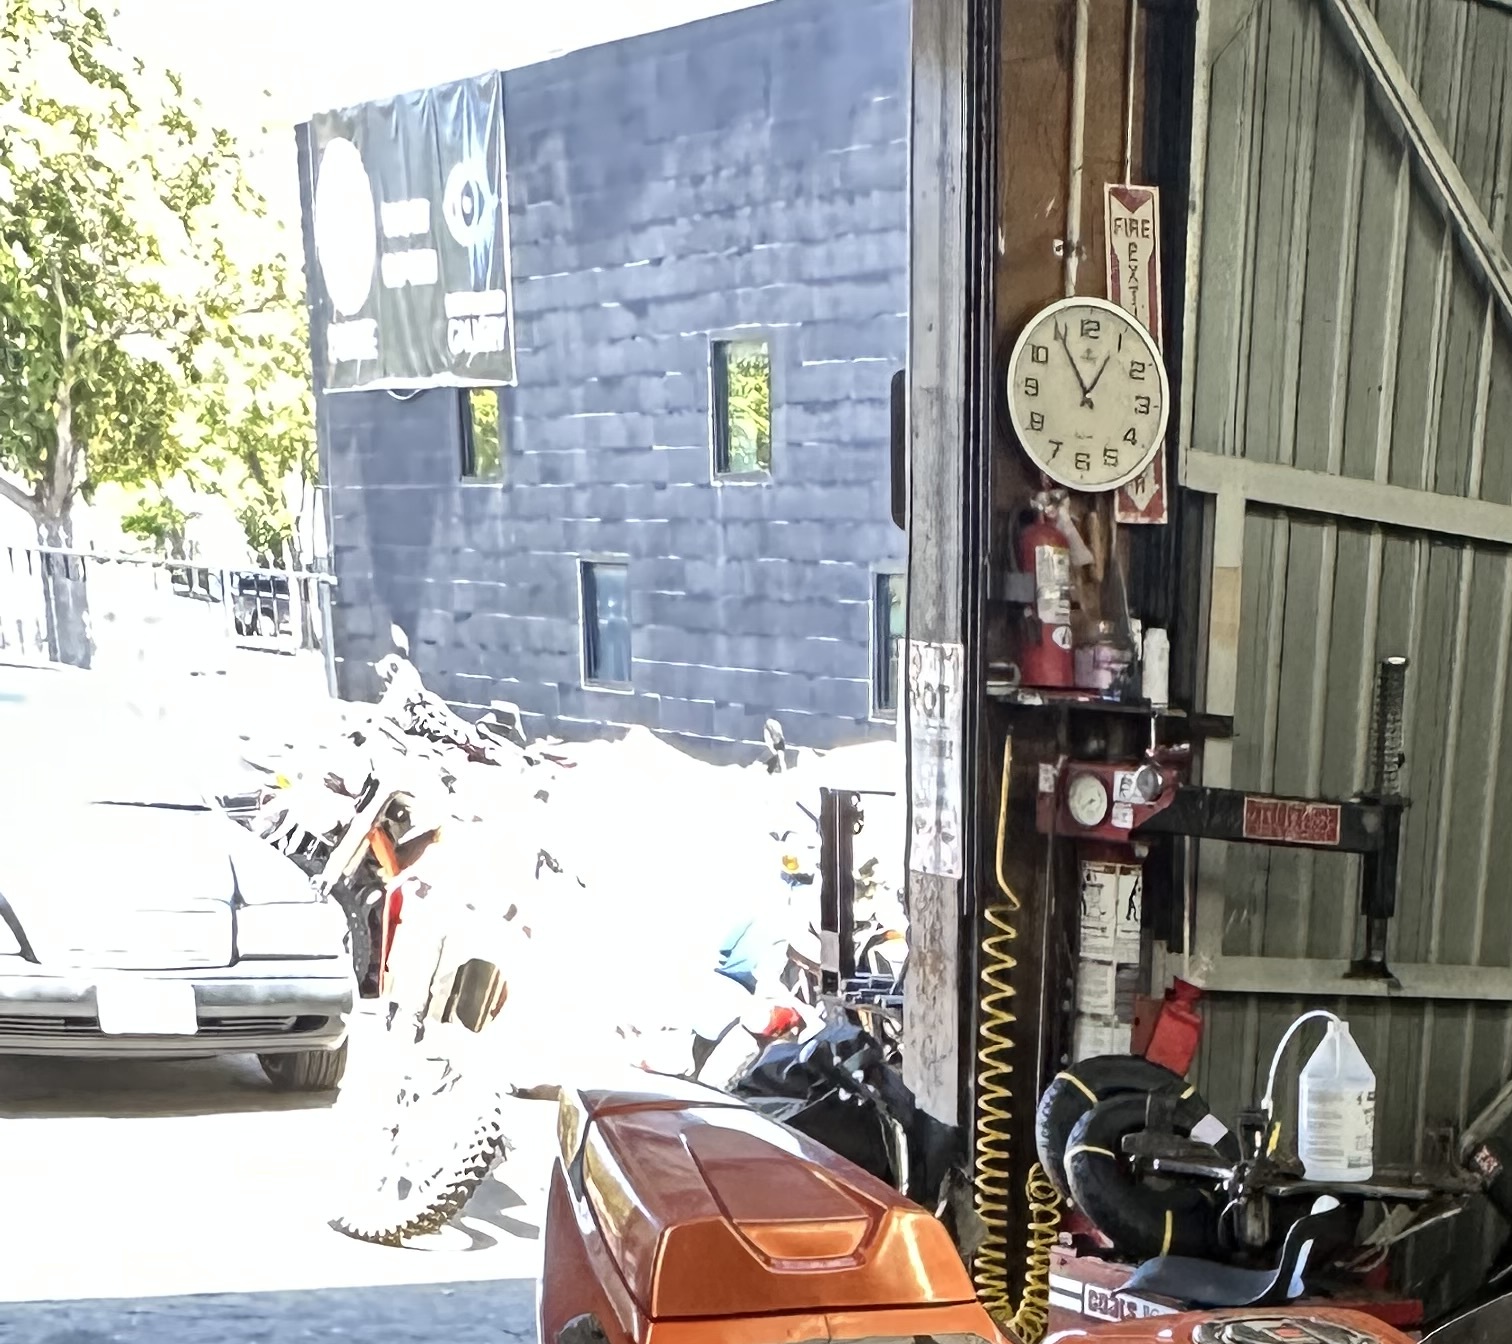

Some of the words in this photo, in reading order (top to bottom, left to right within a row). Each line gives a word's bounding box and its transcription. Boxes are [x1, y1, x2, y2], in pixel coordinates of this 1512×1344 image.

[1113, 217, 1150, 238] FIRE
[1080, 319, 1100, 339] 12
[1117, 333, 1123, 353] 1
[1031, 344, 1049, 364] 10
[1129, 360, 1146, 380] 2
[1025, 378, 1039, 397] 9
[1134, 395, 1151, 415] 3
[1030, 411, 1045, 431] 8
[1123, 428, 1138, 446] 4
[1048, 439, 1064, 459] 7
[1103, 447, 1119, 467] 5
[1075, 453, 1091, 471] 6
